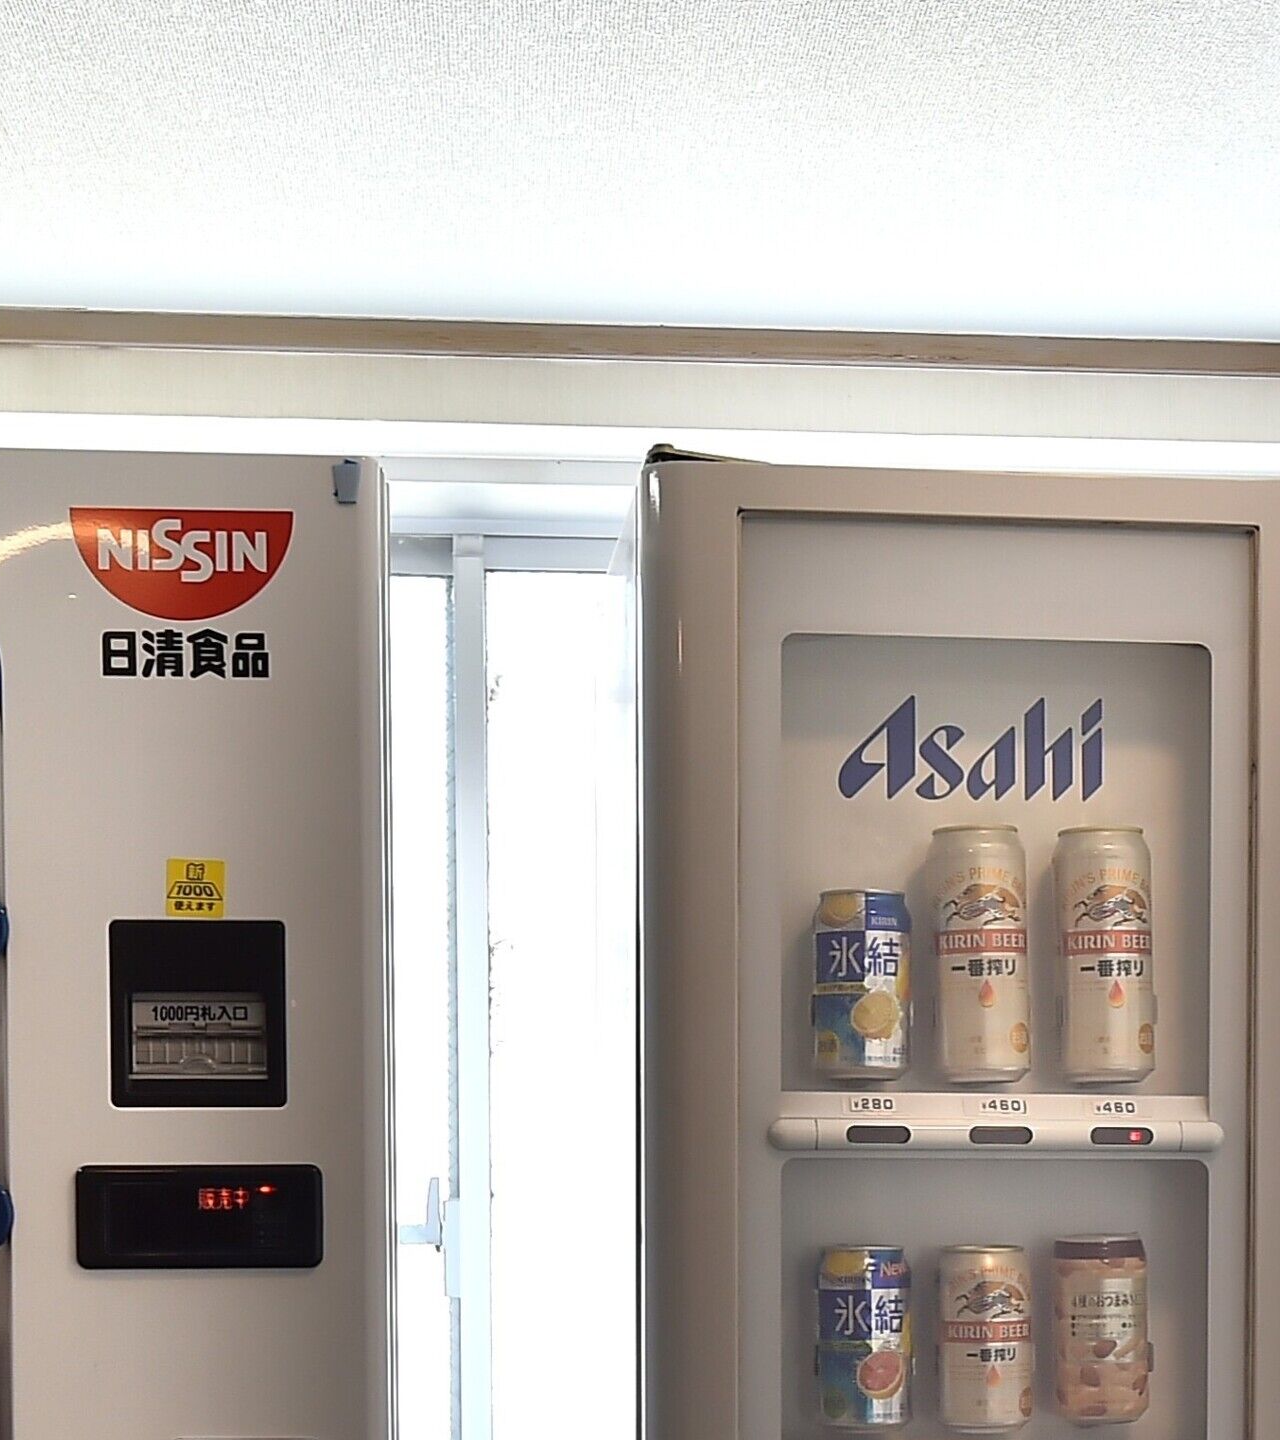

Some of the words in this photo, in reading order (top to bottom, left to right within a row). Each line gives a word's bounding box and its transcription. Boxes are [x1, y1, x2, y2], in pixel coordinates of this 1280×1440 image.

[97, 518, 268, 583] NISSIN
[101, 628, 270, 678] 日清食品
[837, 694, 1104, 802] Asahi
[176, 884, 214, 897] 1000
[940, 933, 986, 949] KIRIN
[1068, 934, 1115, 950] KIRIN
[828, 936, 902, 977] 氷結
[951, 958, 1017, 977] 一番搾り
[1080, 959, 1144, 978] 一番搾り
[151, 1005, 248, 1022] 1000円札入口
[198, 1186, 250, 1210] 販売中
[834, 1295, 903, 1336] 氷結
[948, 1324, 993, 1339] KIRIN
[999, 1323, 1030, 1338] BEER
[966, 1347, 1017, 1362] 一番搾り
